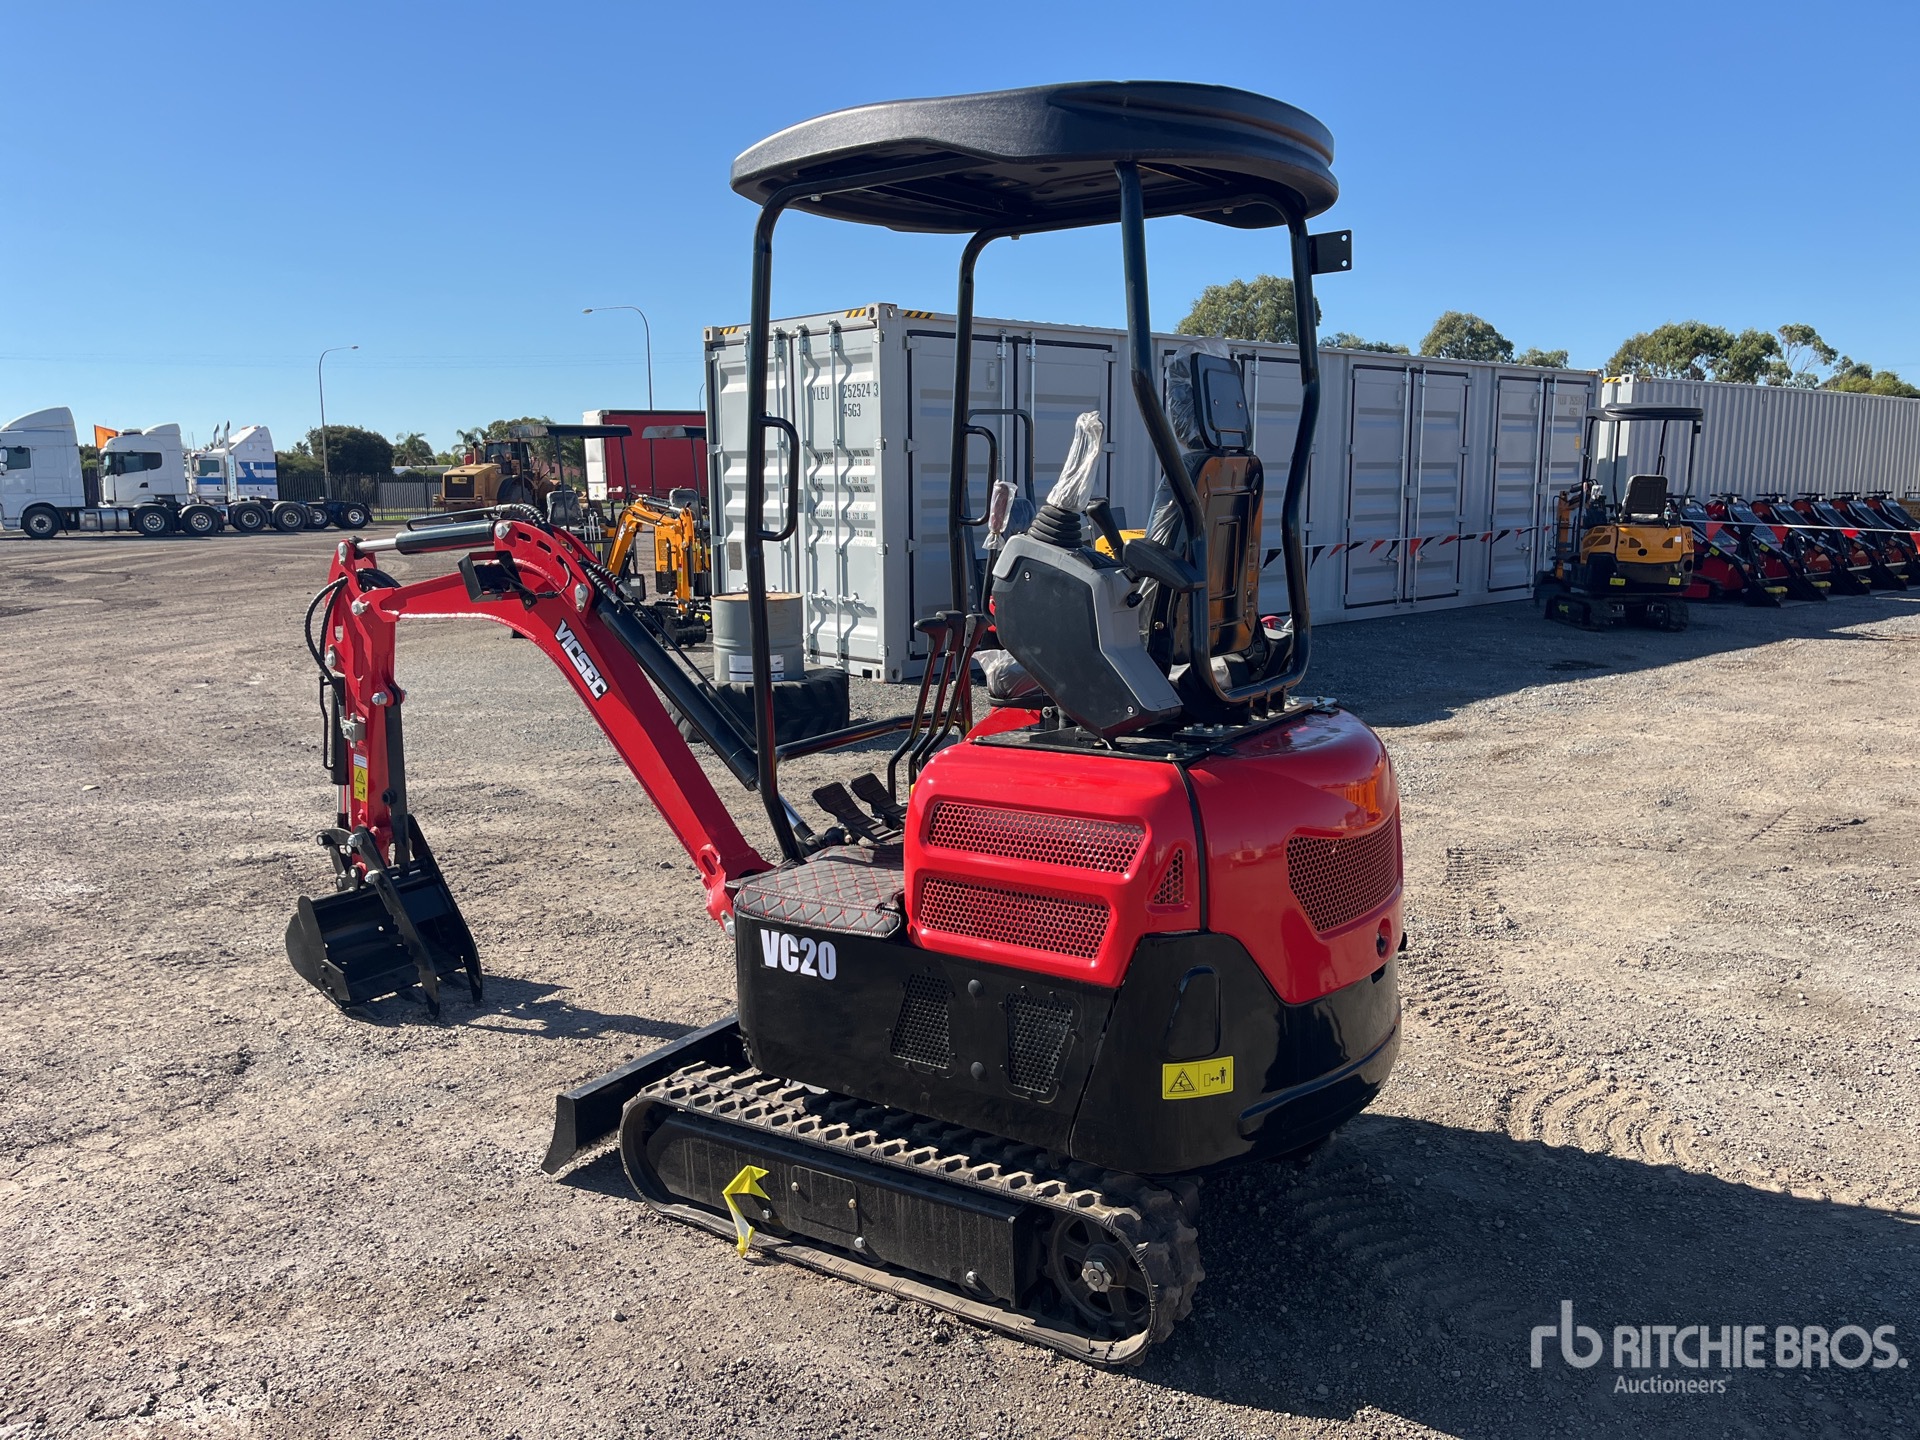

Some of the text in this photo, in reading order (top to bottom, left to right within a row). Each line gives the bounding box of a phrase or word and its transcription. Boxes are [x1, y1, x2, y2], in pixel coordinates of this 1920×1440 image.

[812, 382, 879, 400] YLEU 252524 3
[843, 403, 861, 417] 45G3
[555, 618, 608, 699] VICSEC
[760, 928, 837, 981] VC20
